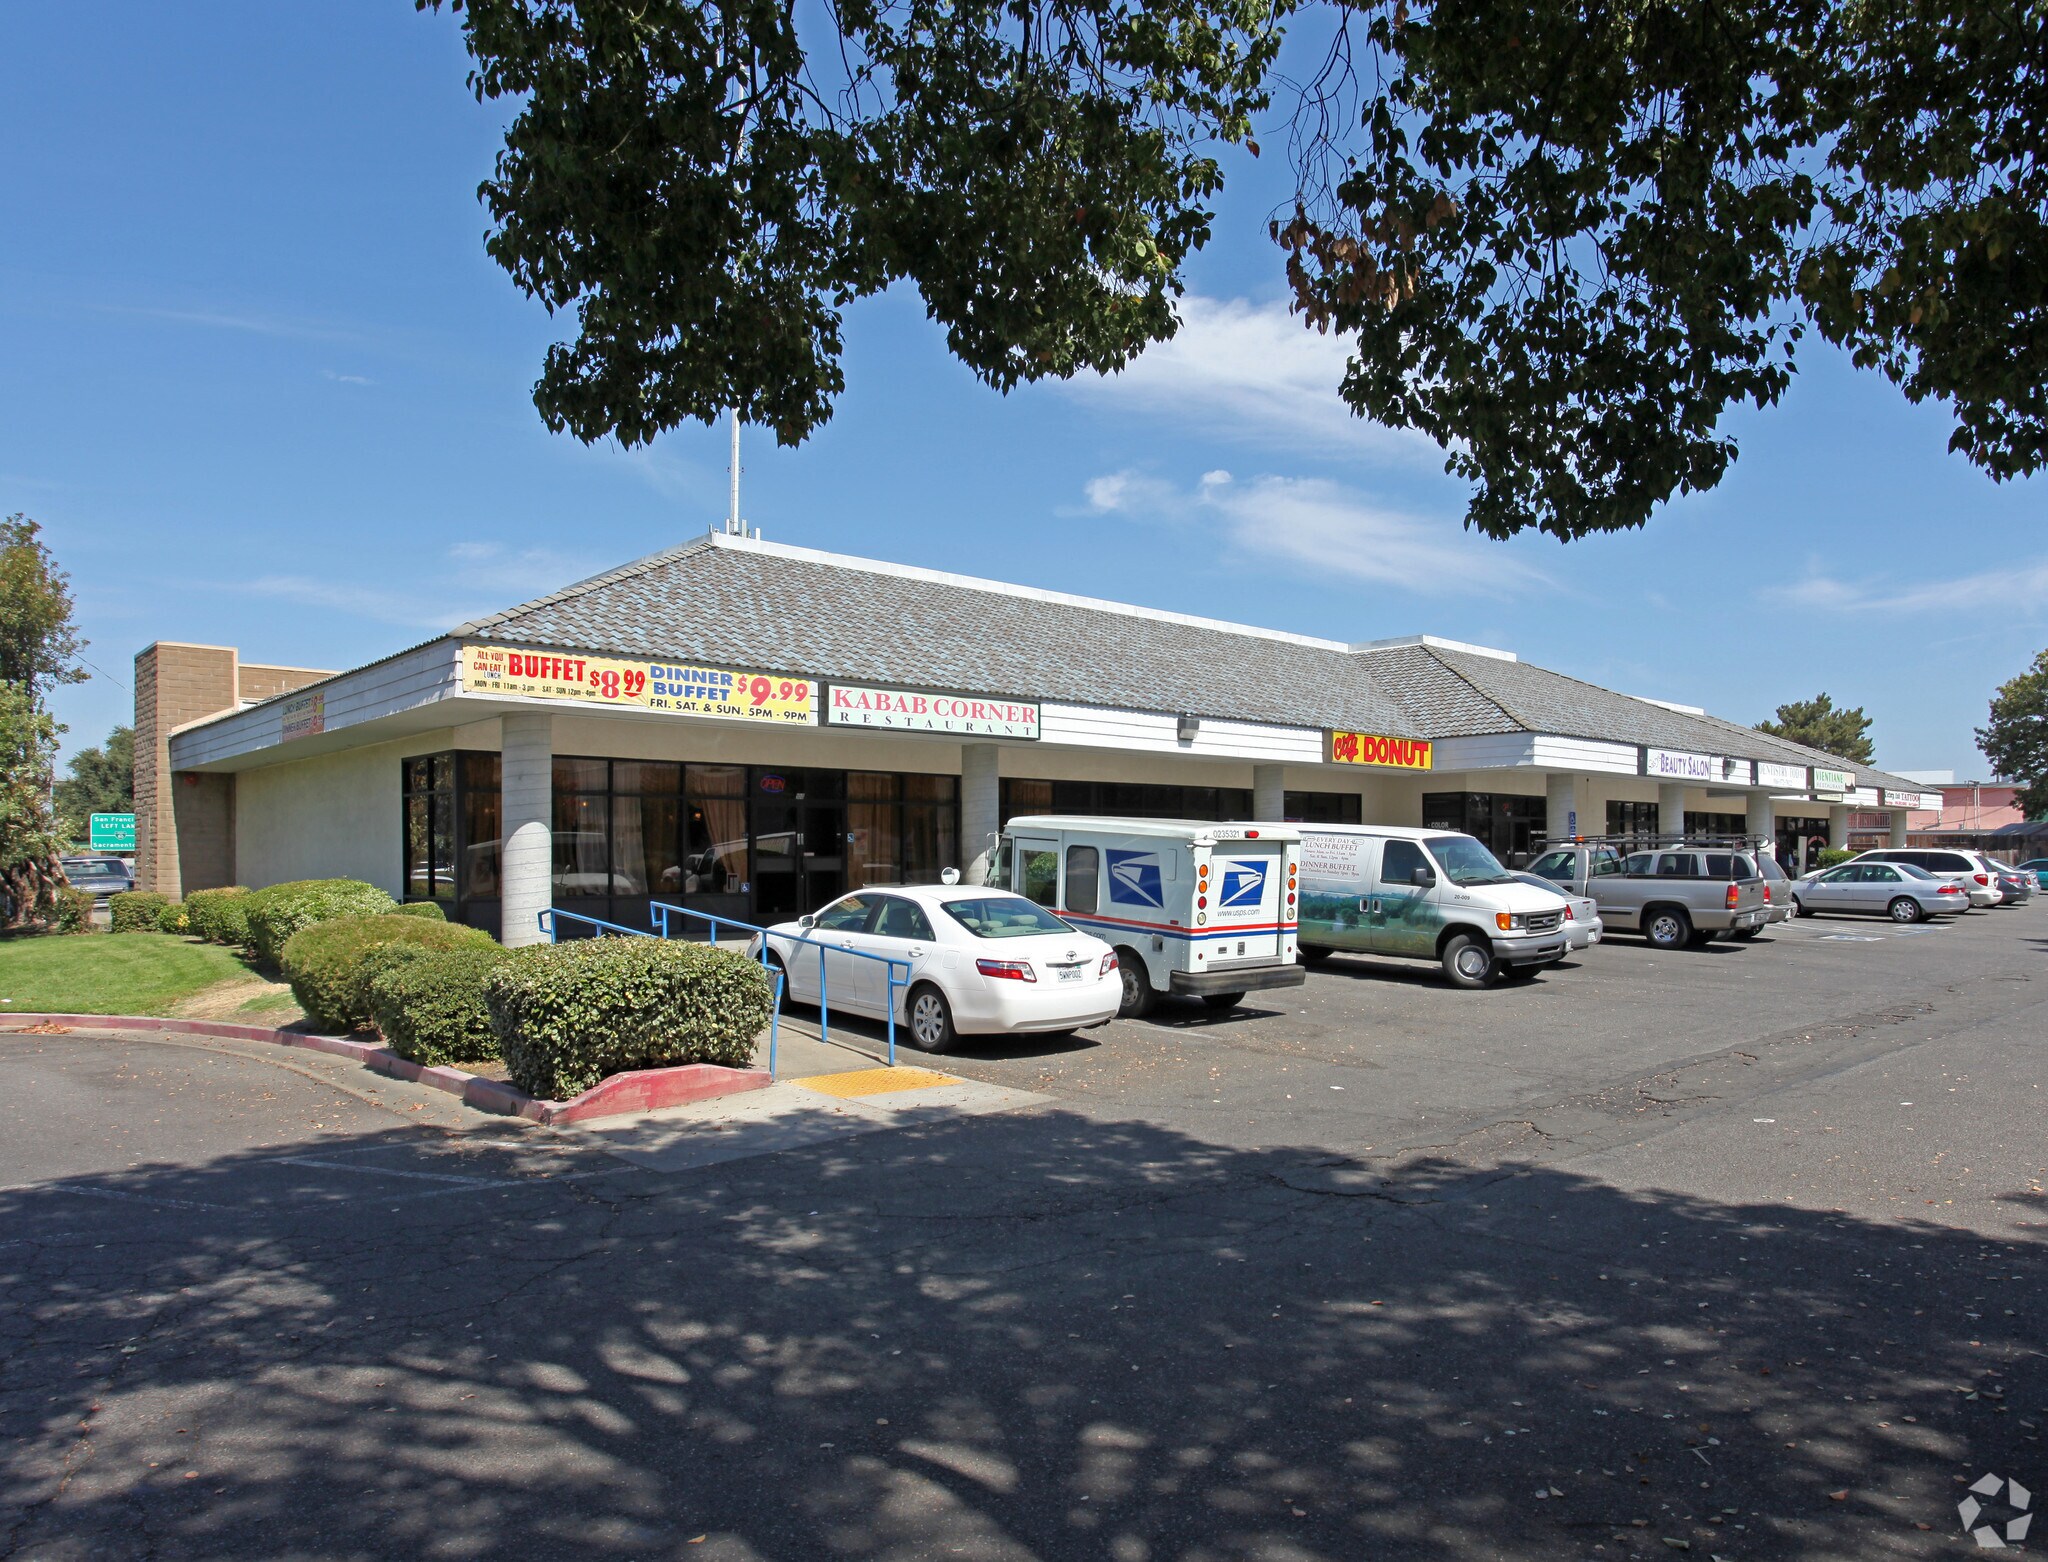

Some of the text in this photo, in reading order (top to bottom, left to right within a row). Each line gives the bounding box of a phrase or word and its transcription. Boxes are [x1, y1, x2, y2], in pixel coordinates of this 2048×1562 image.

[477, 650, 504, 661] ALL YOU
[474, 662, 487, 671] CAN
[490, 664, 501, 672] EAT
[484, 671, 501, 679] LUNCH
[508, 653, 586, 682] BUFFET
[650, 666, 734, 686] DINNER
[654, 682, 730, 702] BUFFET
[737, 675, 808, 706] $9.99
[650, 698, 671, 709] FRI.
[676, 701, 699, 711] SAT.
[703, 703, 712, 712] &
[716, 704, 744, 716] SUN.
[749, 708, 772, 718] 5PM
[784, 711, 807, 721] 9PM
[833, 689, 1036, 724] KABAB CORNER
[840, 711, 1031, 736] RESTAURANT
[1364, 736, 1428, 766] DONUT
[1660, 753, 1687, 774] BEAUTY
[1688, 756, 1709, 776] SALON
[1213, 830, 1240, 838] 0235321
[1329, 863, 1357, 871] BUFFET
[1217, 909, 1260, 918] www.usps.com
